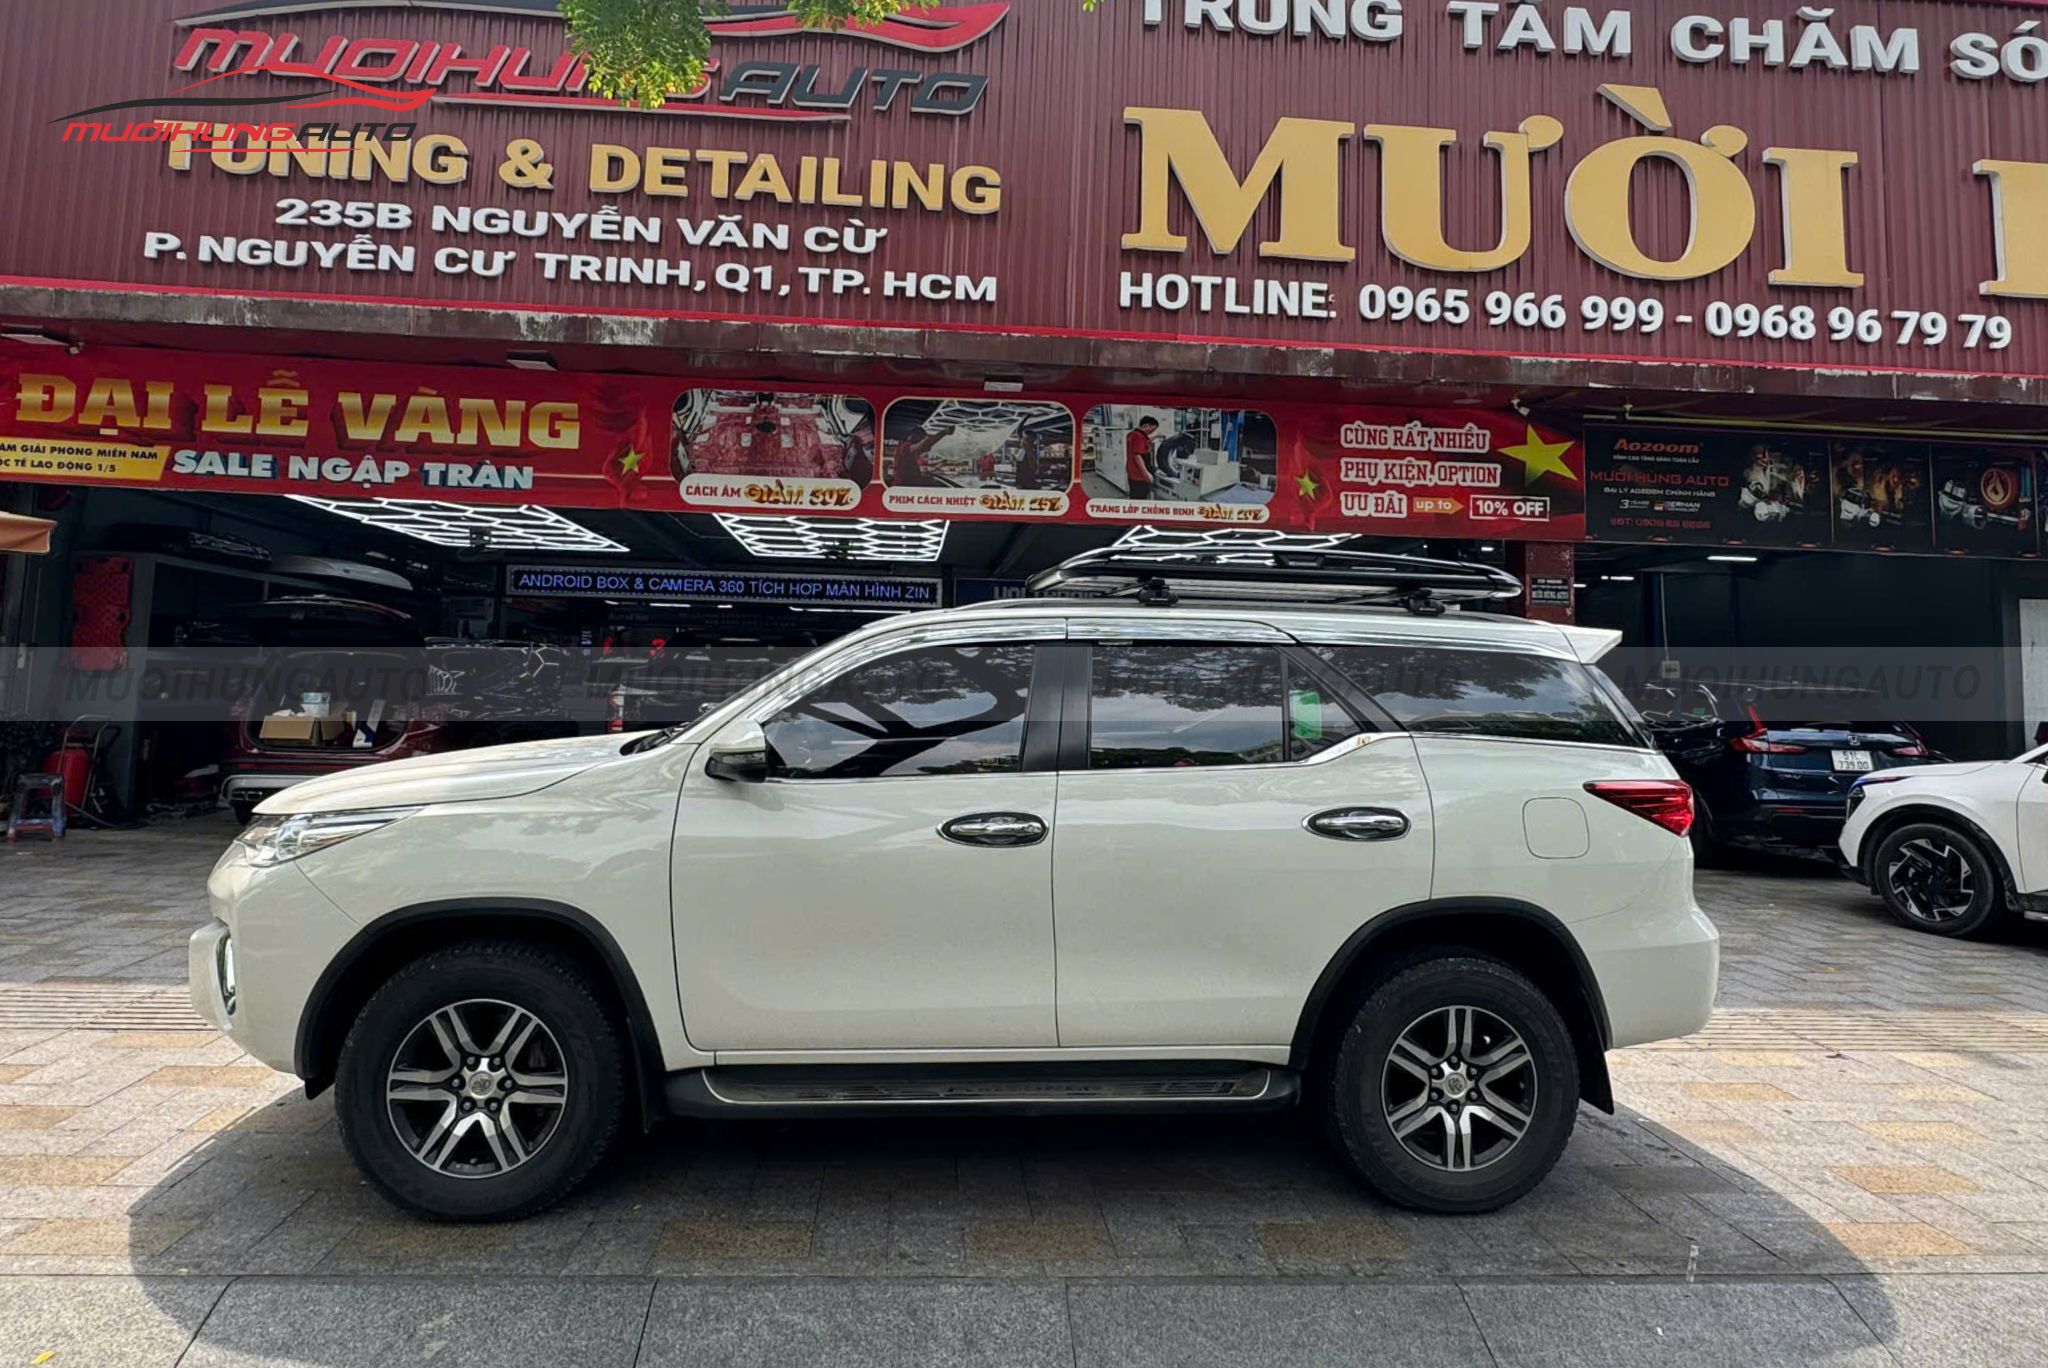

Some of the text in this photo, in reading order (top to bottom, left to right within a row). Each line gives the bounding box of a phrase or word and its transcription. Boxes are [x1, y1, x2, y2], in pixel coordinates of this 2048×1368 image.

[1671, 6, 1919, 73] CHĂM
[154, 119, 1000, 214] TUNING & DETAILING
[1121, 83, 1864, 289] MƯỜI
[275, 198, 888, 254] 235B NGUYỄN VĂN CỪ
[144, 231, 187, 260] P.
[198, 233, 416, 272] NGUYỄN
[435, 247, 517, 277] CƯ
[798, 266, 871, 295] TP.
[883, 270, 997, 301] HCM
[1119, 271, 1337, 317] HOTLINE:
[1359, 284, 1470, 324] 0965
[1485, 291, 1566, 329] 966
[1581, 296, 1663, 332] 999
[1705, 301, 1816, 340] 0968
[1828, 306, 1882, 344] 96
[1892, 310, 1947, 346] 79
[1958, 313, 2012, 349] 79
[16, 369, 580, 449] ĐẠI LỄ VÀNG
[1343, 421, 1488, 450] CÙNG RẤT NHIỀU
[1614, 438, 1700, 454] Aozoom
[31, 460, 53, 469] LAO
[98, 464, 116, 473] 1/5
[172, 449, 535, 489] SALE NGẬP TRÀN
[1343, 463, 1379, 483] PHỤ
[1437, 467, 1498, 484] OPTION
[1685, 475, 1730, 487] AUTO
[686, 478, 853, 506] CÁCH ÂM GIẢM 30%
[889, 494, 915, 505] PHIM
[917, 494, 943, 505] CÁCH
[1374, 491, 1404, 515] ĐÃI
[1415, 499, 1434, 511] up
[1437, 499, 1453, 510] to
[1475, 500, 1509, 516] 10%
[1513, 501, 1544, 516] OFF
[519, 574, 593, 588] ANDROID
[596, 575, 630, 590] BOX
[634, 576, 645, 590] &
[648, 577, 716, 592] CAMERA
[718, 580, 745, 593] 360
[749, 578, 785, 595] TÍCH
[905, 585, 930, 599] ZIN
